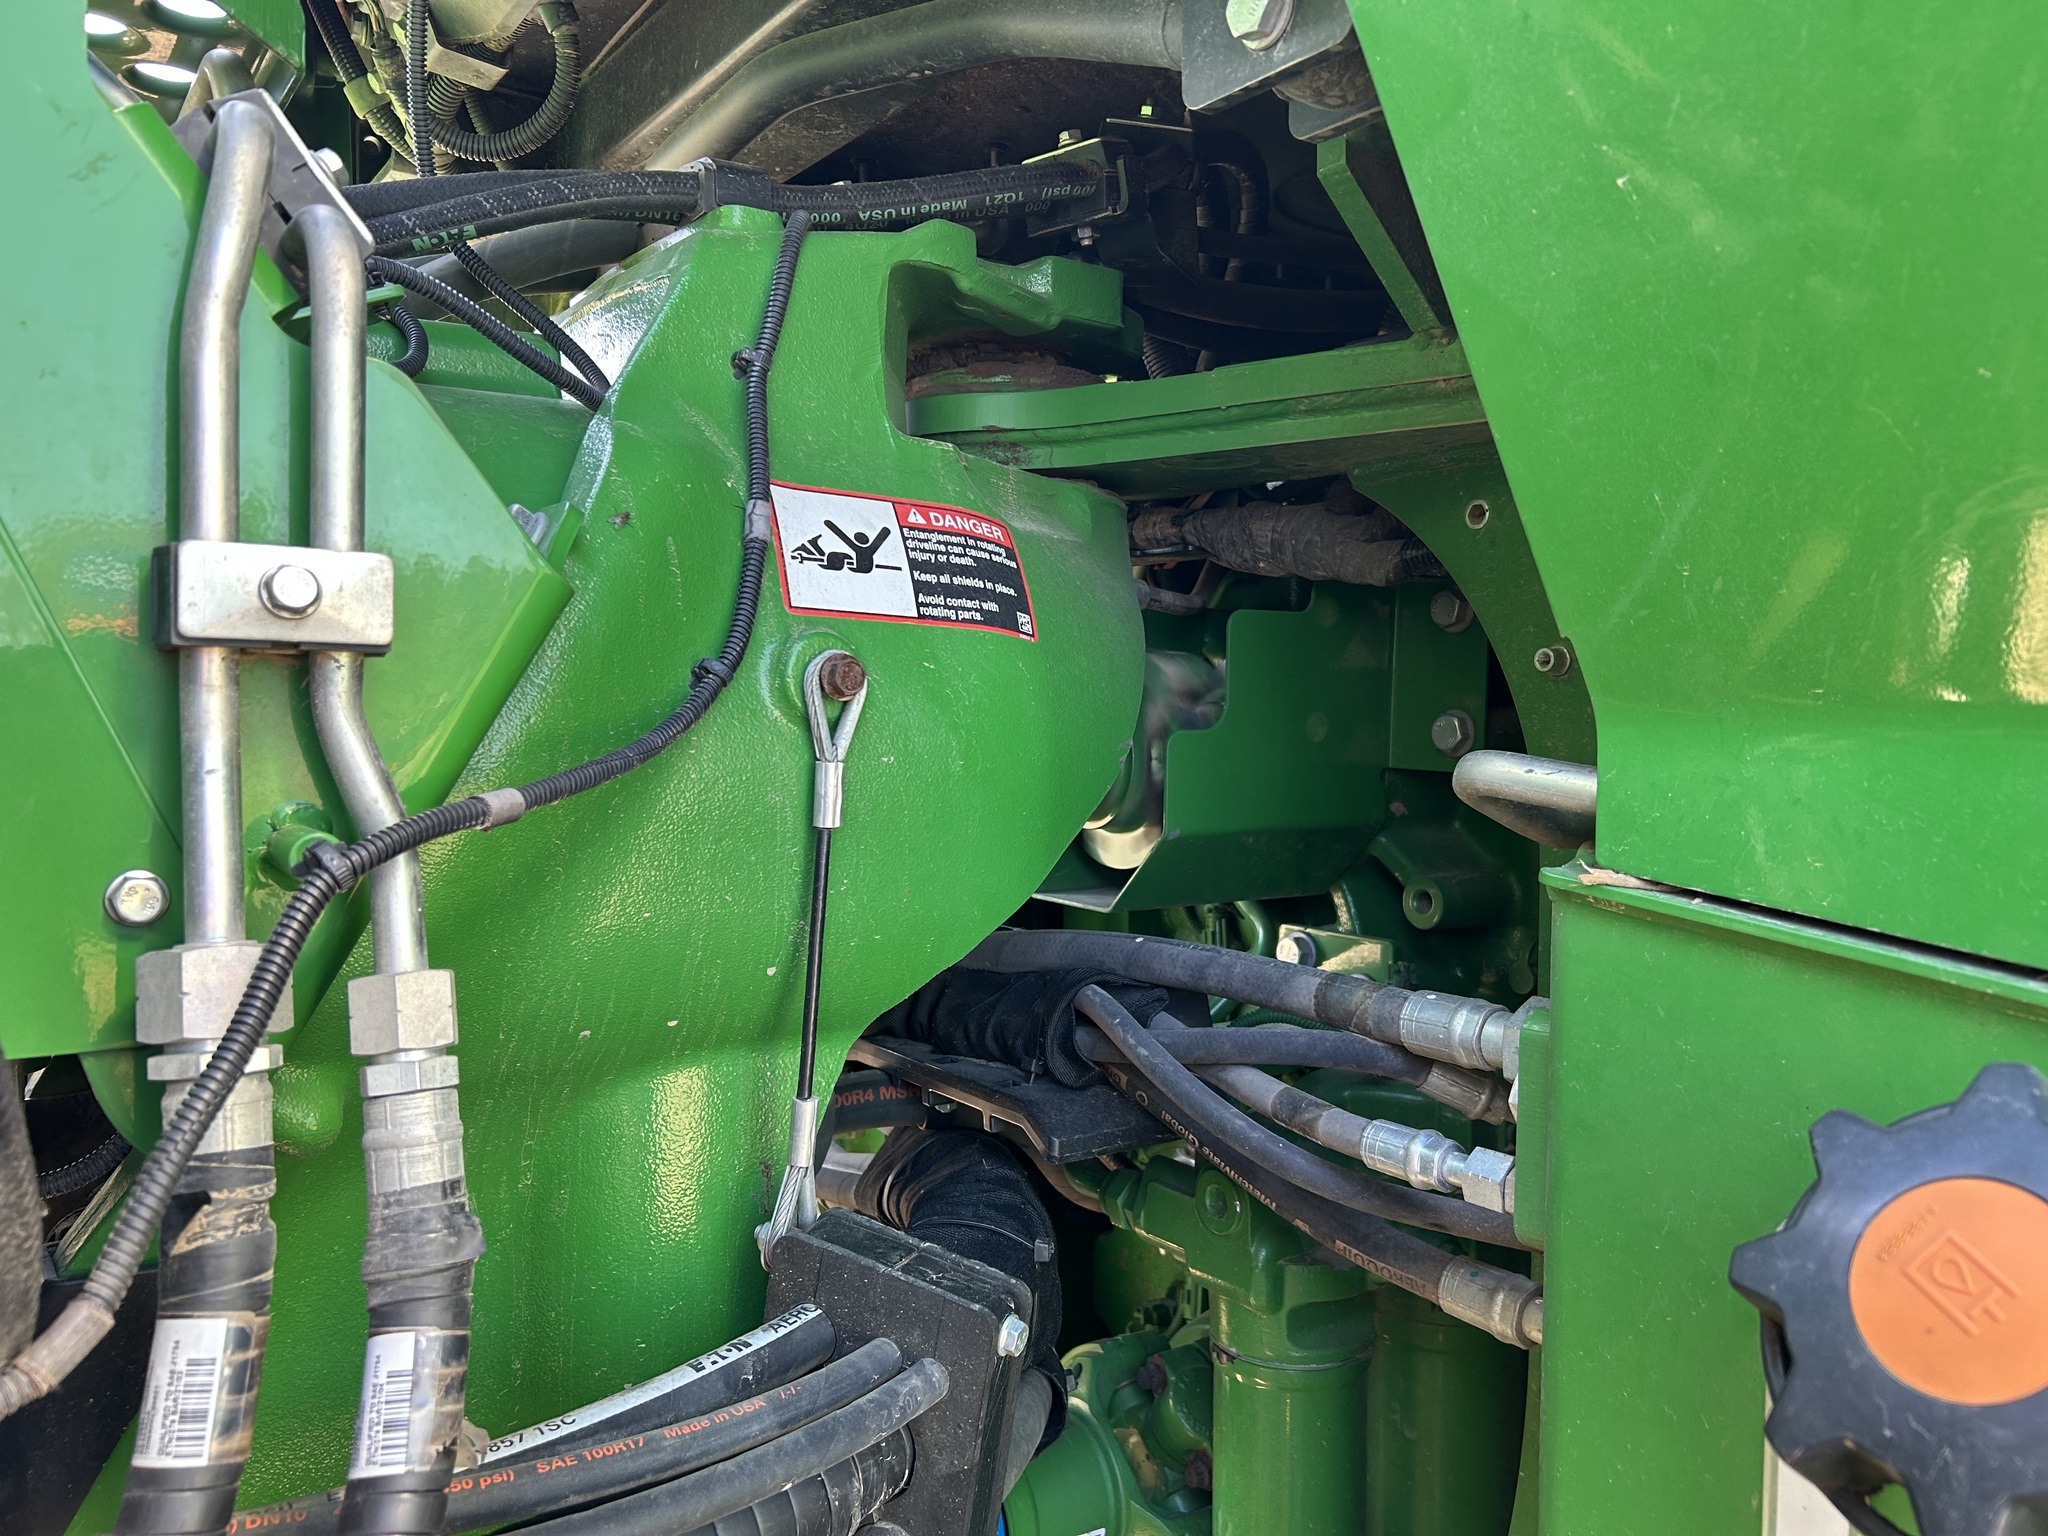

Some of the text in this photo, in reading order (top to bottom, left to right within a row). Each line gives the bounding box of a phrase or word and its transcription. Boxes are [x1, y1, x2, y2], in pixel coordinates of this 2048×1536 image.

[858, 209, 896, 222] USA
[900, 206, 915, 218] in
[920, 199, 967, 215] Made
[975, 205, 1009, 218] USA
[411, 224, 478, 253] EATON
[929, 511, 1004, 542] DANGER
[903, 528, 1007, 557] Entanglement in rotating
[905, 539, 1018, 569] driveline can cause serious
[908, 548, 977, 567] injury or death.
[913, 570, 1018, 597] Keep all shields in place.
[918, 592, 1000, 612] Avoid contact with
[919, 606, 985, 622] rotating parts.
[1160, 1110, 1199, 1148] Global
[1201, 1145, 1277, 1212] MatchMate
[1335, 1244, 1426, 1295] AEROQUIP
[533, 1414, 577, 1436] 1SC
[686, 1338, 753, 1374] EATON
[244, 1509, 307, 1531] DN10
[443, 1479, 474, 1494] 50
[478, 1468, 515, 1490] psi)
[536, 1454, 578, 1475] SAE
[583, 1436, 645, 1461] 100R17
[664, 1418, 711, 1440] Made
[713, 1410, 730, 1424] in
[730, 1398, 767, 1416] USA
